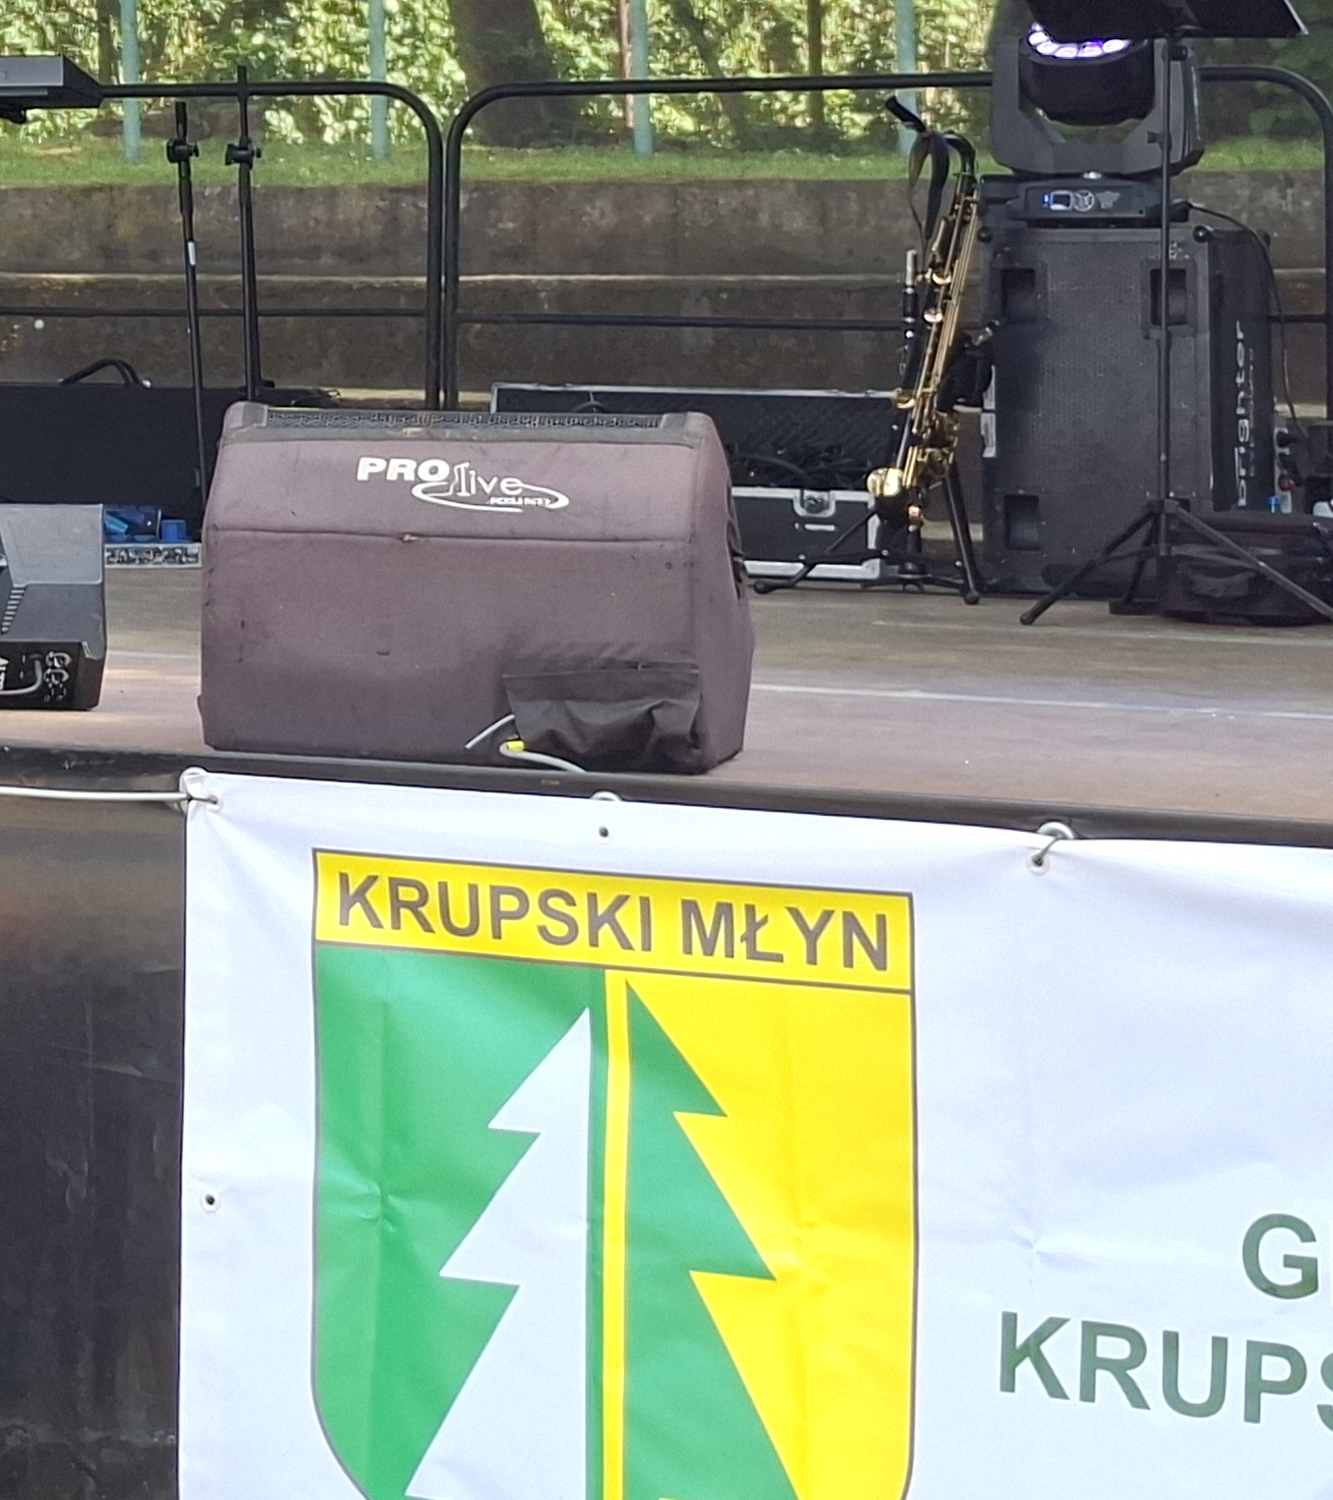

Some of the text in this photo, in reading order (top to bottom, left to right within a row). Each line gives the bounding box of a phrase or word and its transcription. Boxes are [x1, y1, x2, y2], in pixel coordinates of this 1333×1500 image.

[357, 457, 450, 482] PRO
[337, 872, 888, 972] KRUPSKI MŁYN
[999, 1311, 1333, 1432] KRUP
